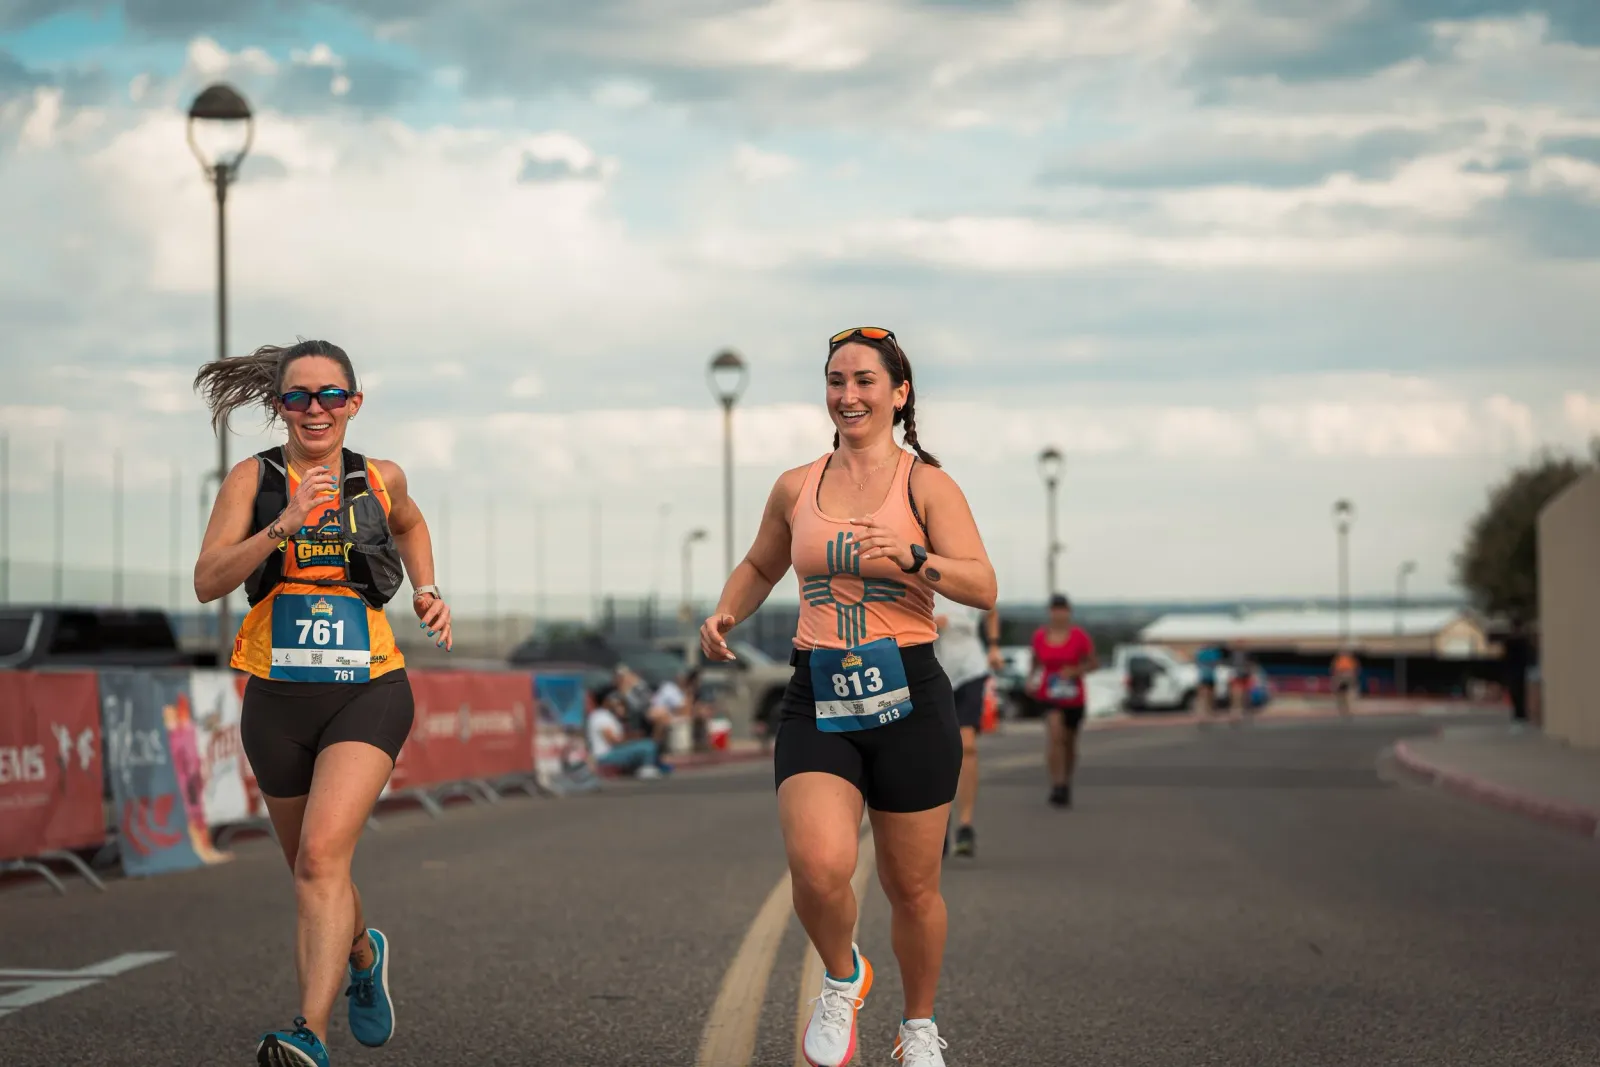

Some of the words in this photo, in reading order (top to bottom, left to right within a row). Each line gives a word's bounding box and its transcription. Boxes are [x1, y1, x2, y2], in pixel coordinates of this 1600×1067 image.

[295, 619, 344, 645] 761
[334, 669, 355, 681] 761
[831, 667, 884, 698] 813
[878, 708, 900, 724] 813
